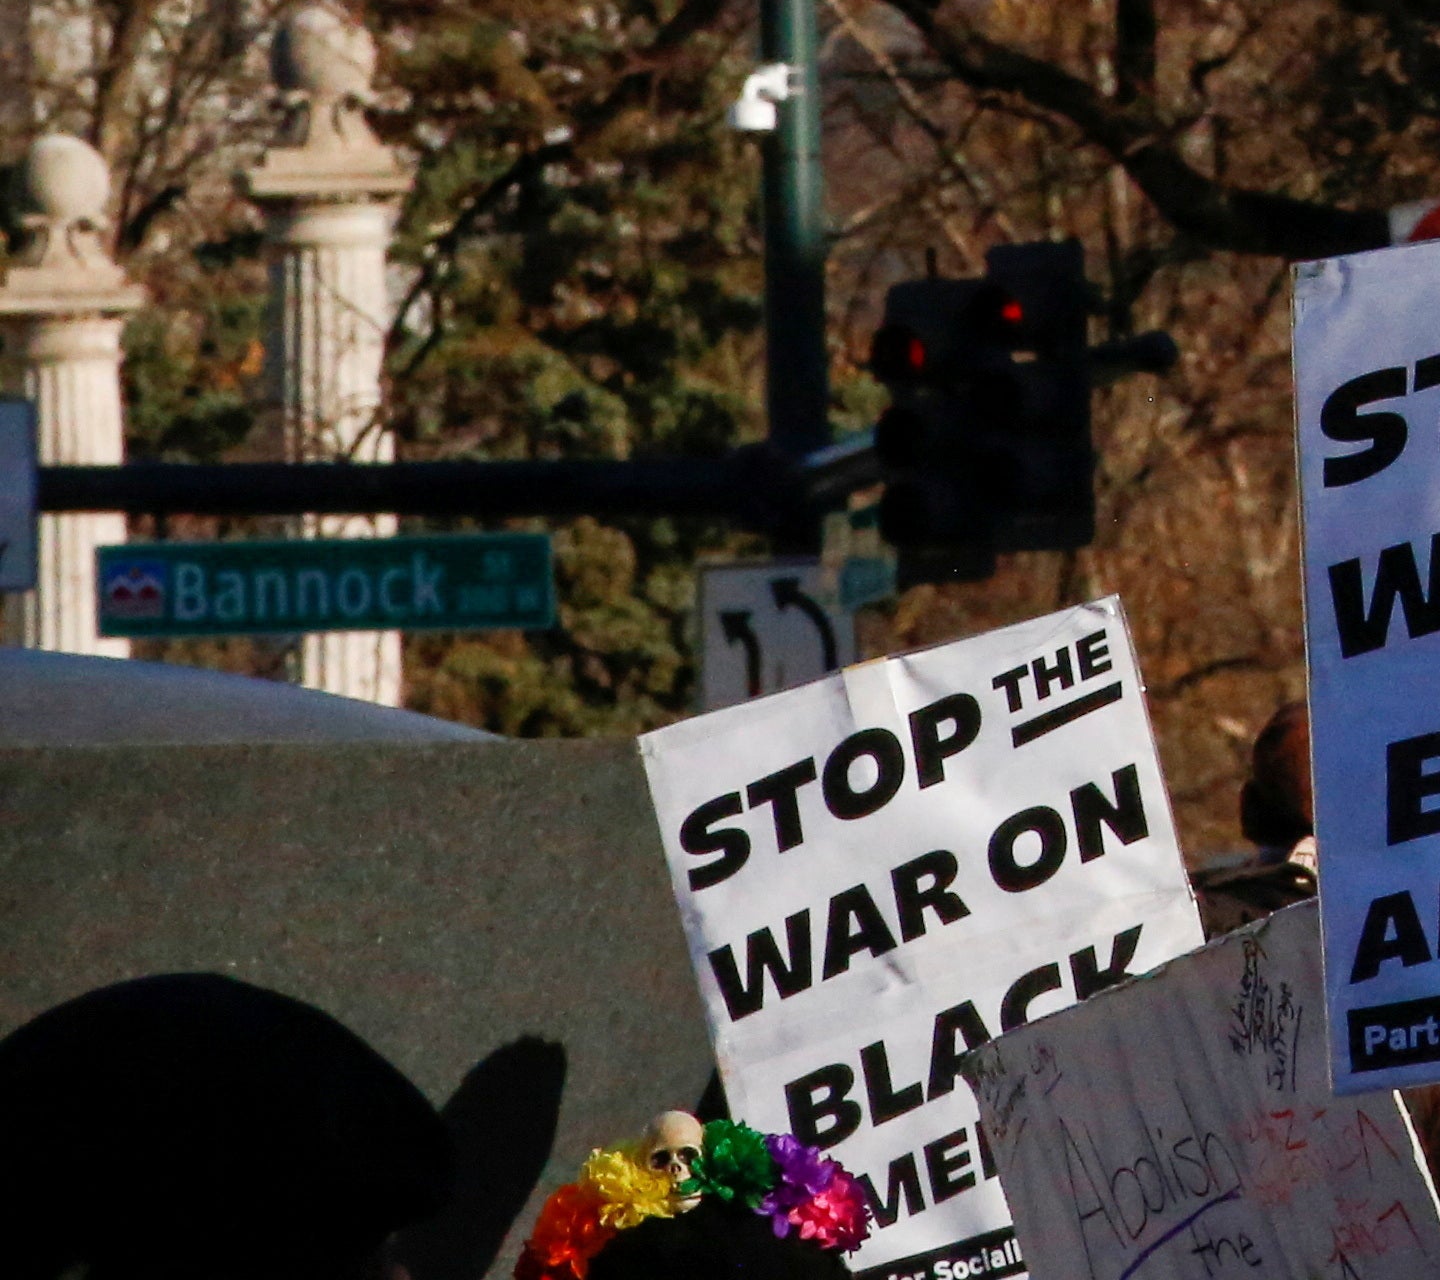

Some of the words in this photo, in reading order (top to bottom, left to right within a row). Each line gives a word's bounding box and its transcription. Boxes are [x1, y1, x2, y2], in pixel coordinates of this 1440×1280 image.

[173, 548, 445, 621] Bannock
[680, 693, 981, 892] STOP
[992, 629, 1112, 713] THE
[706, 850, 971, 1022] WAR
[988, 764, 1149, 893] ON
